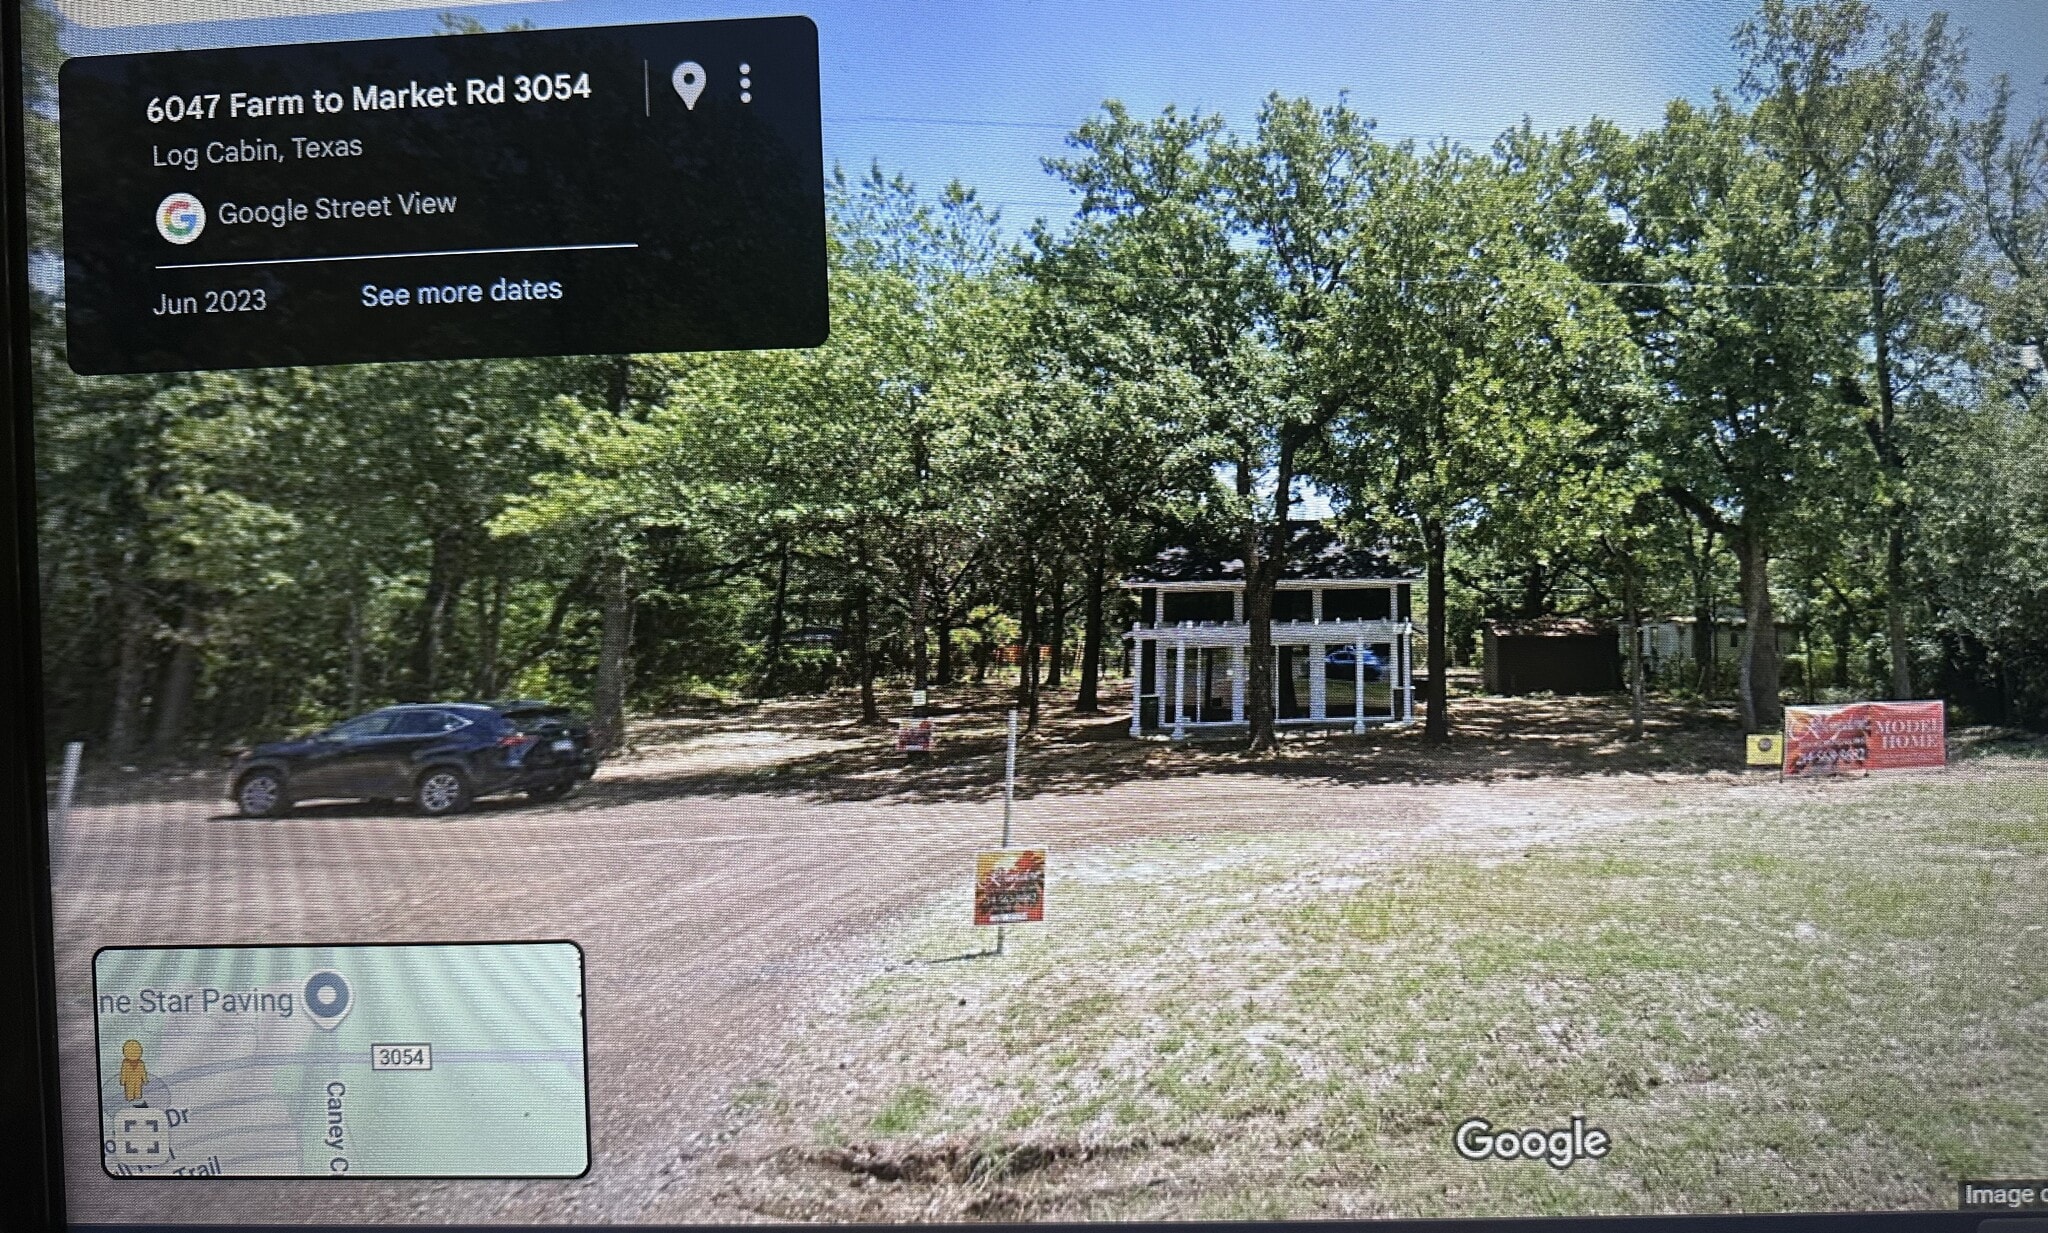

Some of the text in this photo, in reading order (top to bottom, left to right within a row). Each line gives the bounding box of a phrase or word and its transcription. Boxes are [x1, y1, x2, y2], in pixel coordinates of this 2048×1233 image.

[146, 72, 592, 124] 6047 Farm to Market Rd 3054
[153, 137, 363, 171] Log Cabin, Texas
[162, 200, 198, 236] G
[218, 191, 457, 228] Google Street View
[153, 288, 267, 316] Jun 2023
[362, 277, 563, 308] See more dates
[1875, 718, 1940, 751] MODEL HOME
[139, 989, 192, 1013] Star
[202, 988, 294, 1016] Paving
[380, 1048, 424, 1067] 3054
[165, 1108, 190, 1128] Dr
[325, 1081, 346, 1151] Caney
[1456, 1118, 1609, 1168] Google
[1965, 1184, 2034, 1208] Image
